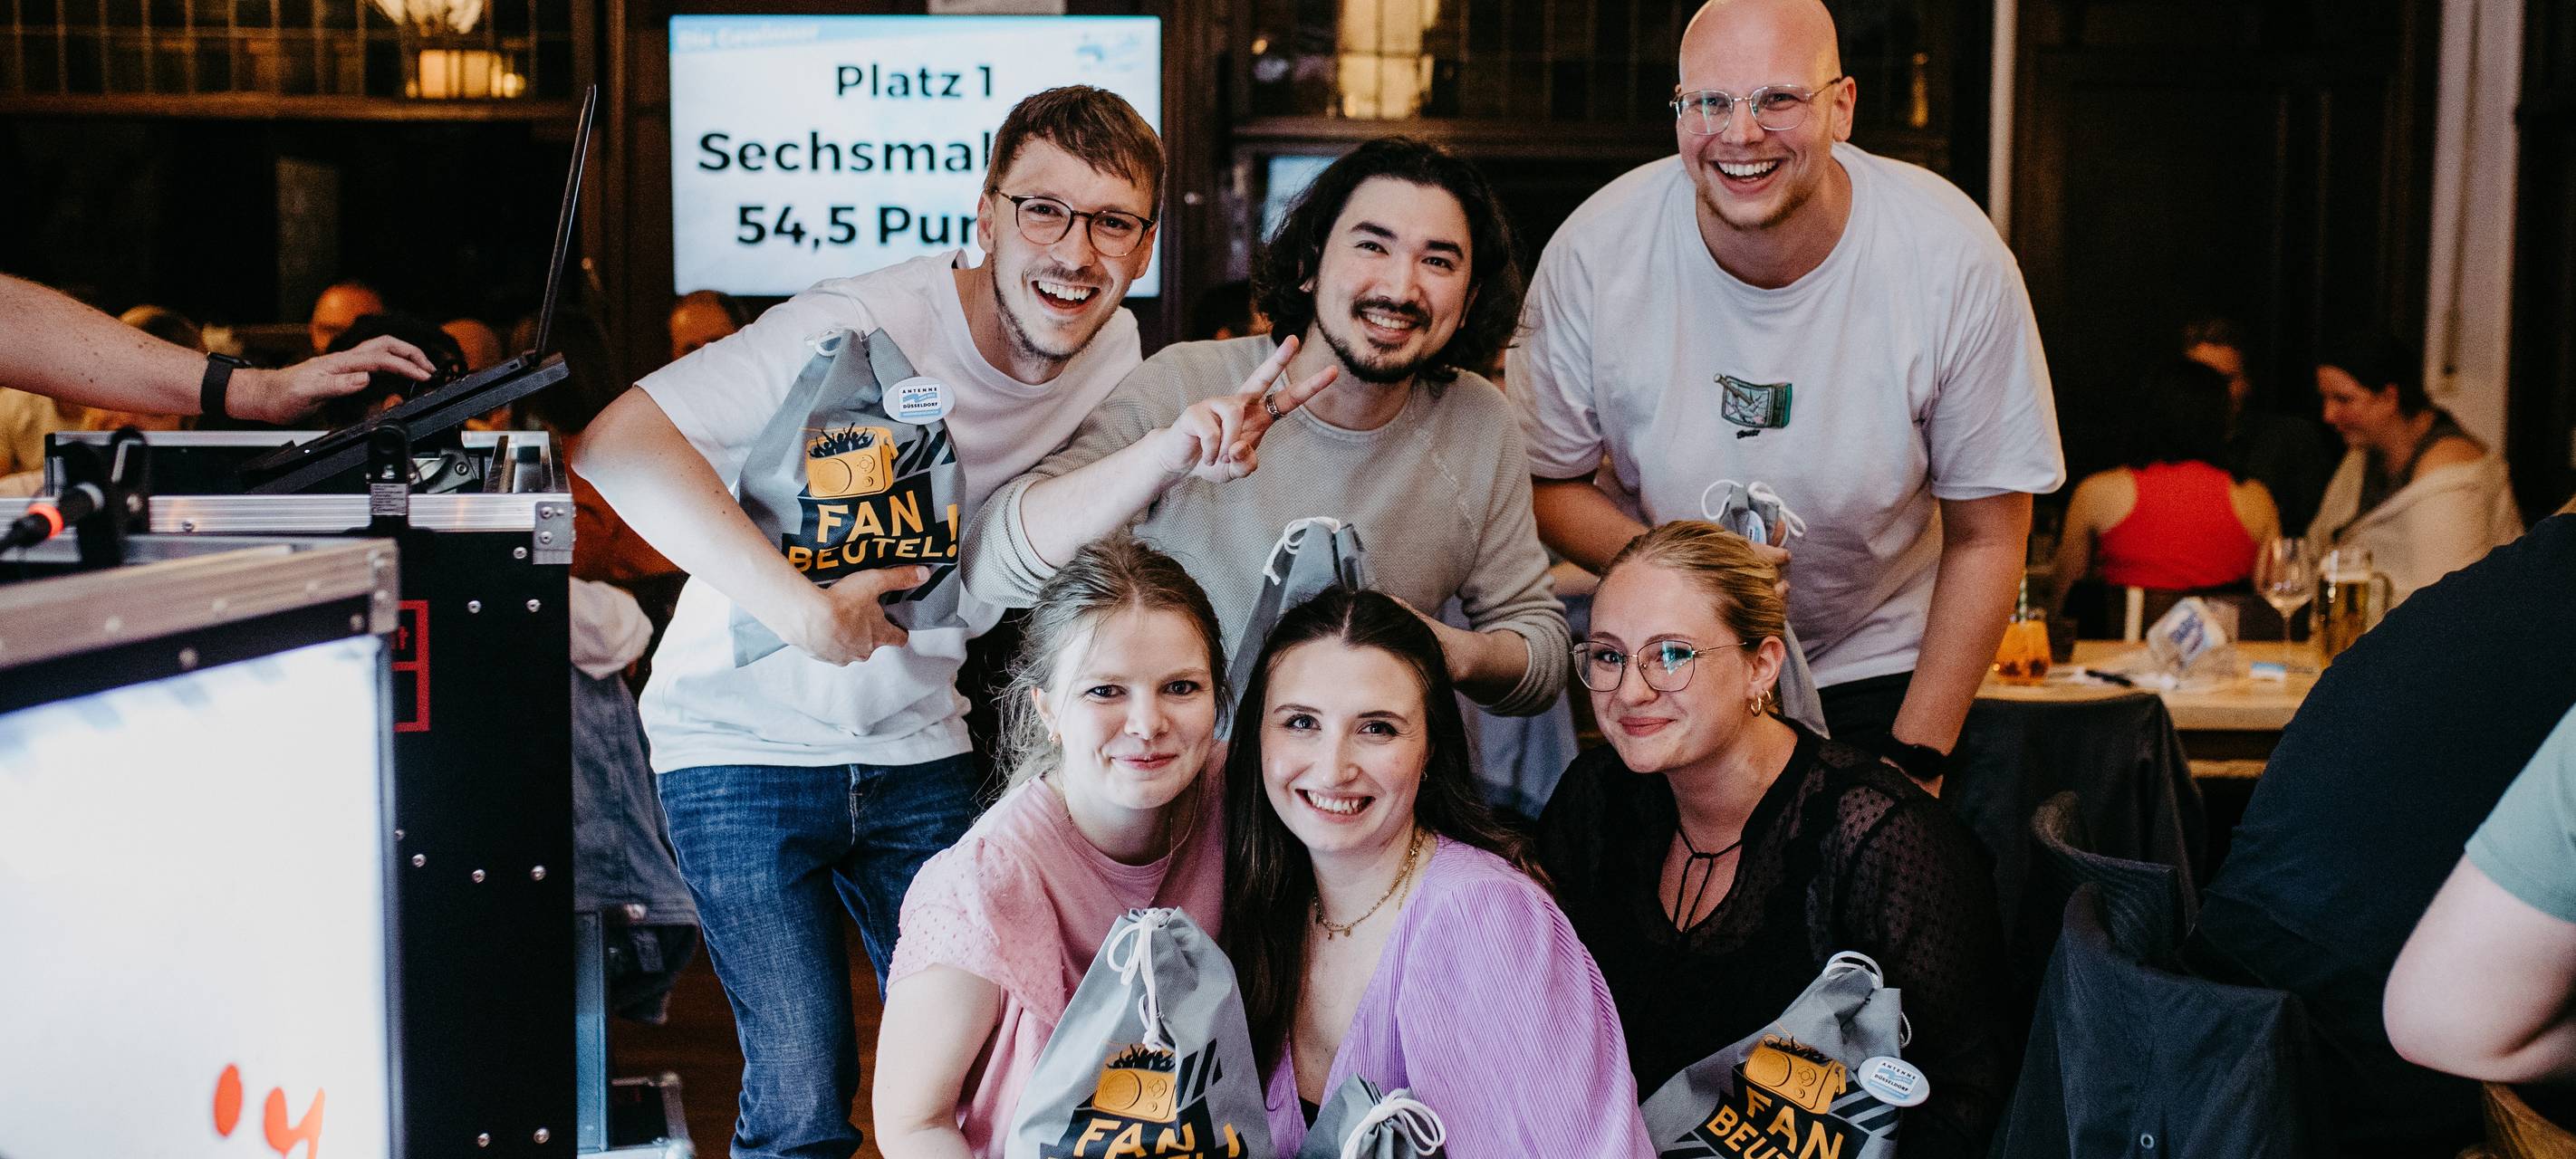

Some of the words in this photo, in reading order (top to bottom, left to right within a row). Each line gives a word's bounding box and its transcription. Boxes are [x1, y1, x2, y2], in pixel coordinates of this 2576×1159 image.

[836, 63, 961, 97] Platz
[977, 66, 991, 97] 1
[697, 131, 990, 172] Sechsmal
[737, 206, 857, 251] 54,5
[817, 490, 924, 543] FAN
[1874, 1074, 1908, 1092] DÜSSELDORF
[1881, 1062, 1917, 1080] ANTENNE
[1073, 1118, 1196, 1159] FAN
[1706, 1104, 1789, 1159] BEU
[1746, 1086, 1844, 1159] FAN
